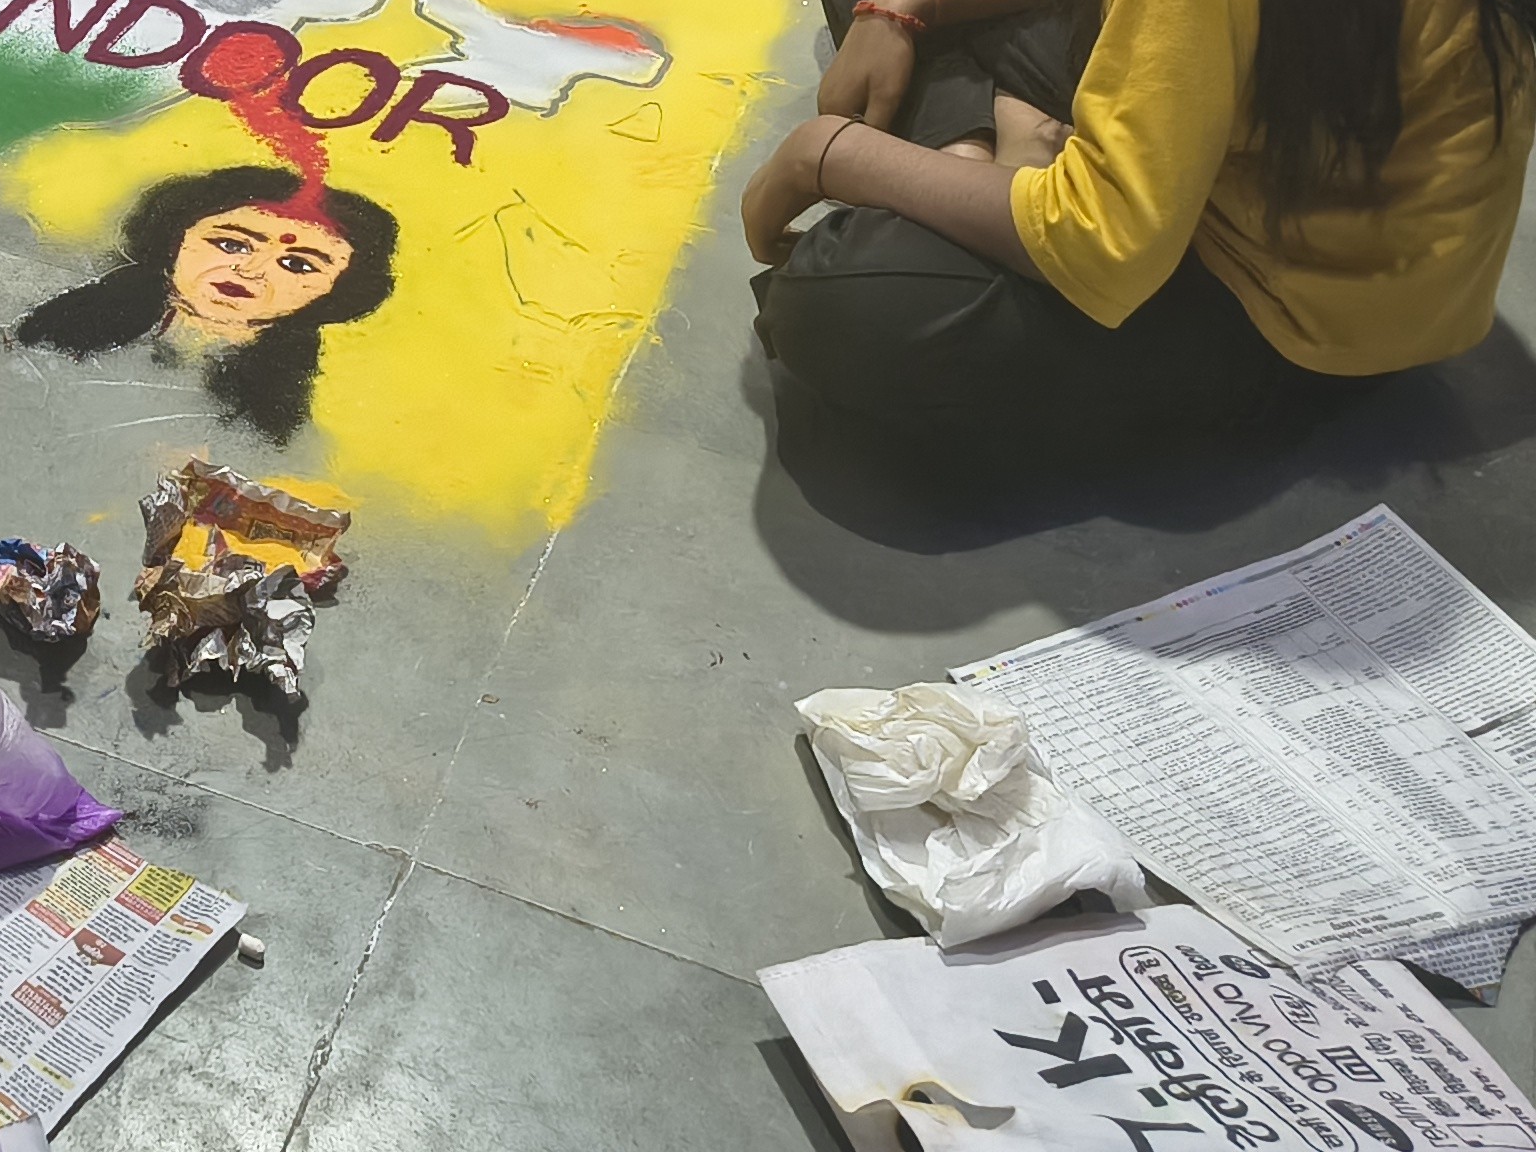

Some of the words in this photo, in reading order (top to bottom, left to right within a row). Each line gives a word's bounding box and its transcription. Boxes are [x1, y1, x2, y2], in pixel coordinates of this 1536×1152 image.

[1213, 983, 1271, 1036] vivo
[1280, 997, 1316, 1027] itel
[1066, 969, 1280, 1151] टेलीकॉम
[1187, 1029, 1249, 1068] रिचार्ज
[1238, 1071, 1263, 1084] के
[1297, 1117, 1344, 1149] सभी
[1379, 1091, 1459, 1147] realme
